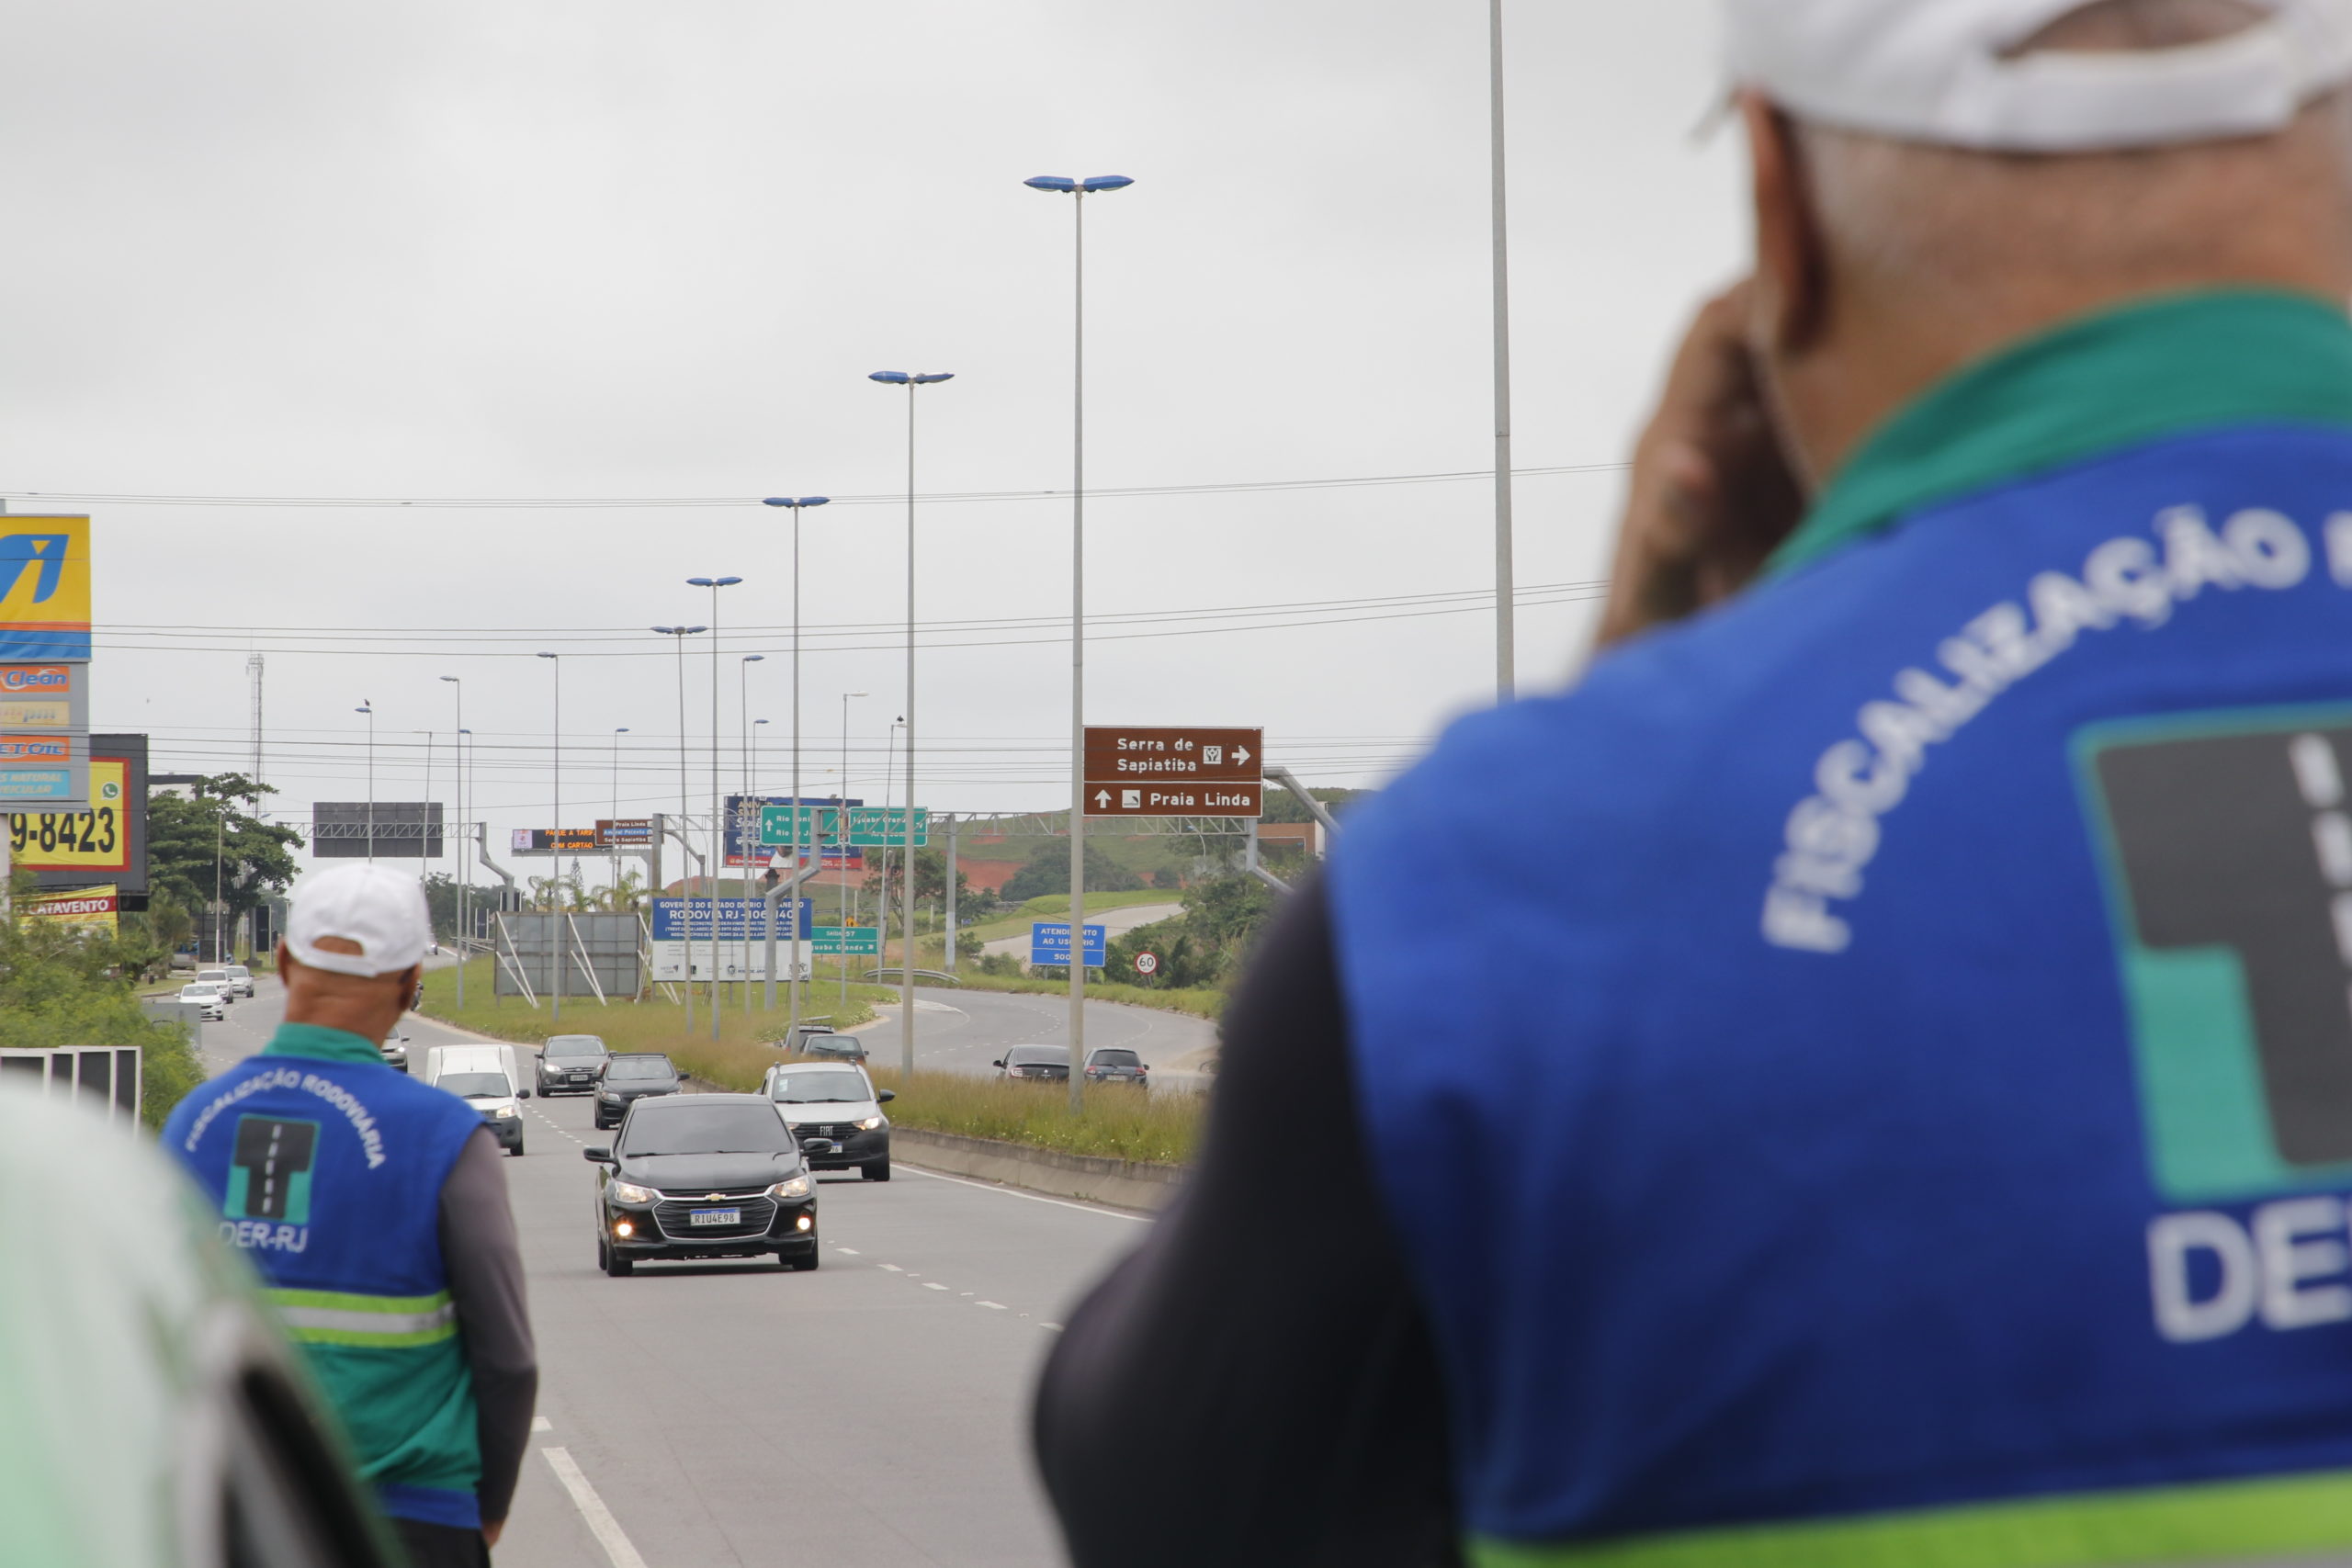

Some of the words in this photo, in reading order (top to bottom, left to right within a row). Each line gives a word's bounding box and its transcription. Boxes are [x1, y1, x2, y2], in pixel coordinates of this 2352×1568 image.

[6, 671, 67, 685] Clean
[1760, 503, 2312, 955] FISCALIZAÇÃO
[0, 742, 65, 755] ETOIL
[1117, 738, 1165, 751] Serra
[1174, 738, 1193, 751] de
[1117, 758, 1196, 773] Sapiatiba
[1150, 792, 1194, 806] Praia
[1204, 793, 1250, 807] Linda
[726, 909, 738, 919] RJ
[1040, 928, 1097, 937] ATENDINTO
[1057, 938, 1095, 946] USRIO
[1139, 956, 1154, 967] 60
[300, 1073, 387, 1170] RODOVIÁRIA
[820, 1125, 834, 1136] FIAT
[695, 1213, 735, 1224] RIU4E98
[219, 1220, 309, 1254] DER-RJ
[2144, 1192, 2352, 1344] DE
